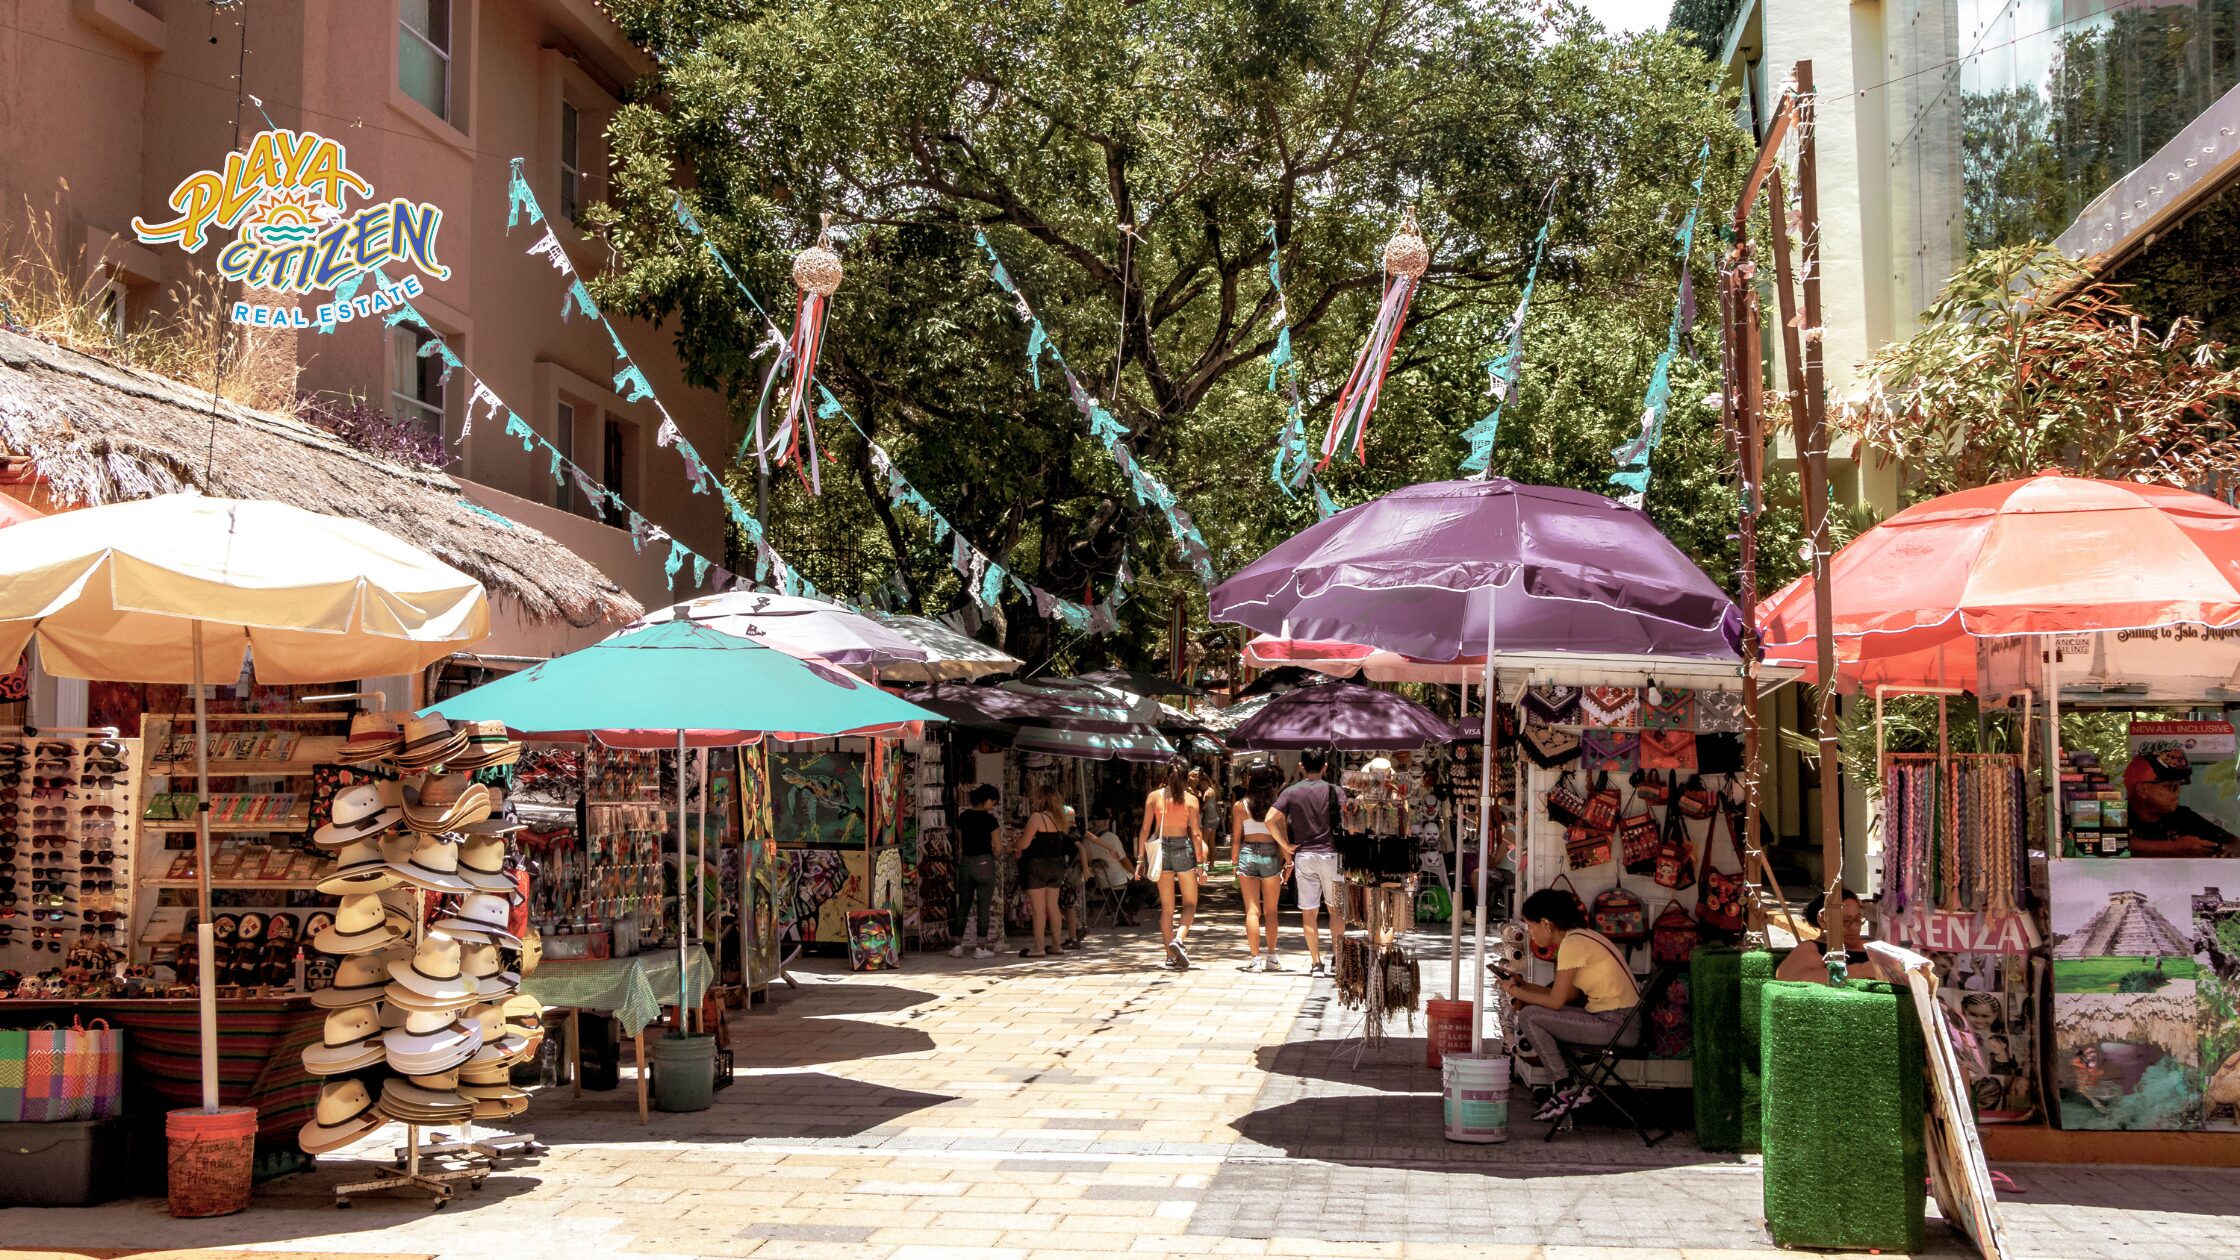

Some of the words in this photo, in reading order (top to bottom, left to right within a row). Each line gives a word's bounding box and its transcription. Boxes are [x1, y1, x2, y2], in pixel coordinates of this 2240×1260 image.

[2117, 628, 2158, 642] Sailing
[2161, 628, 2172, 638] to
[2174, 623, 2198, 641] Isla
[2132, 725, 2154, 733] NEW
[2156, 725, 2175, 733] ALL
[2177, 724, 2231, 733] INCLUSIVE
